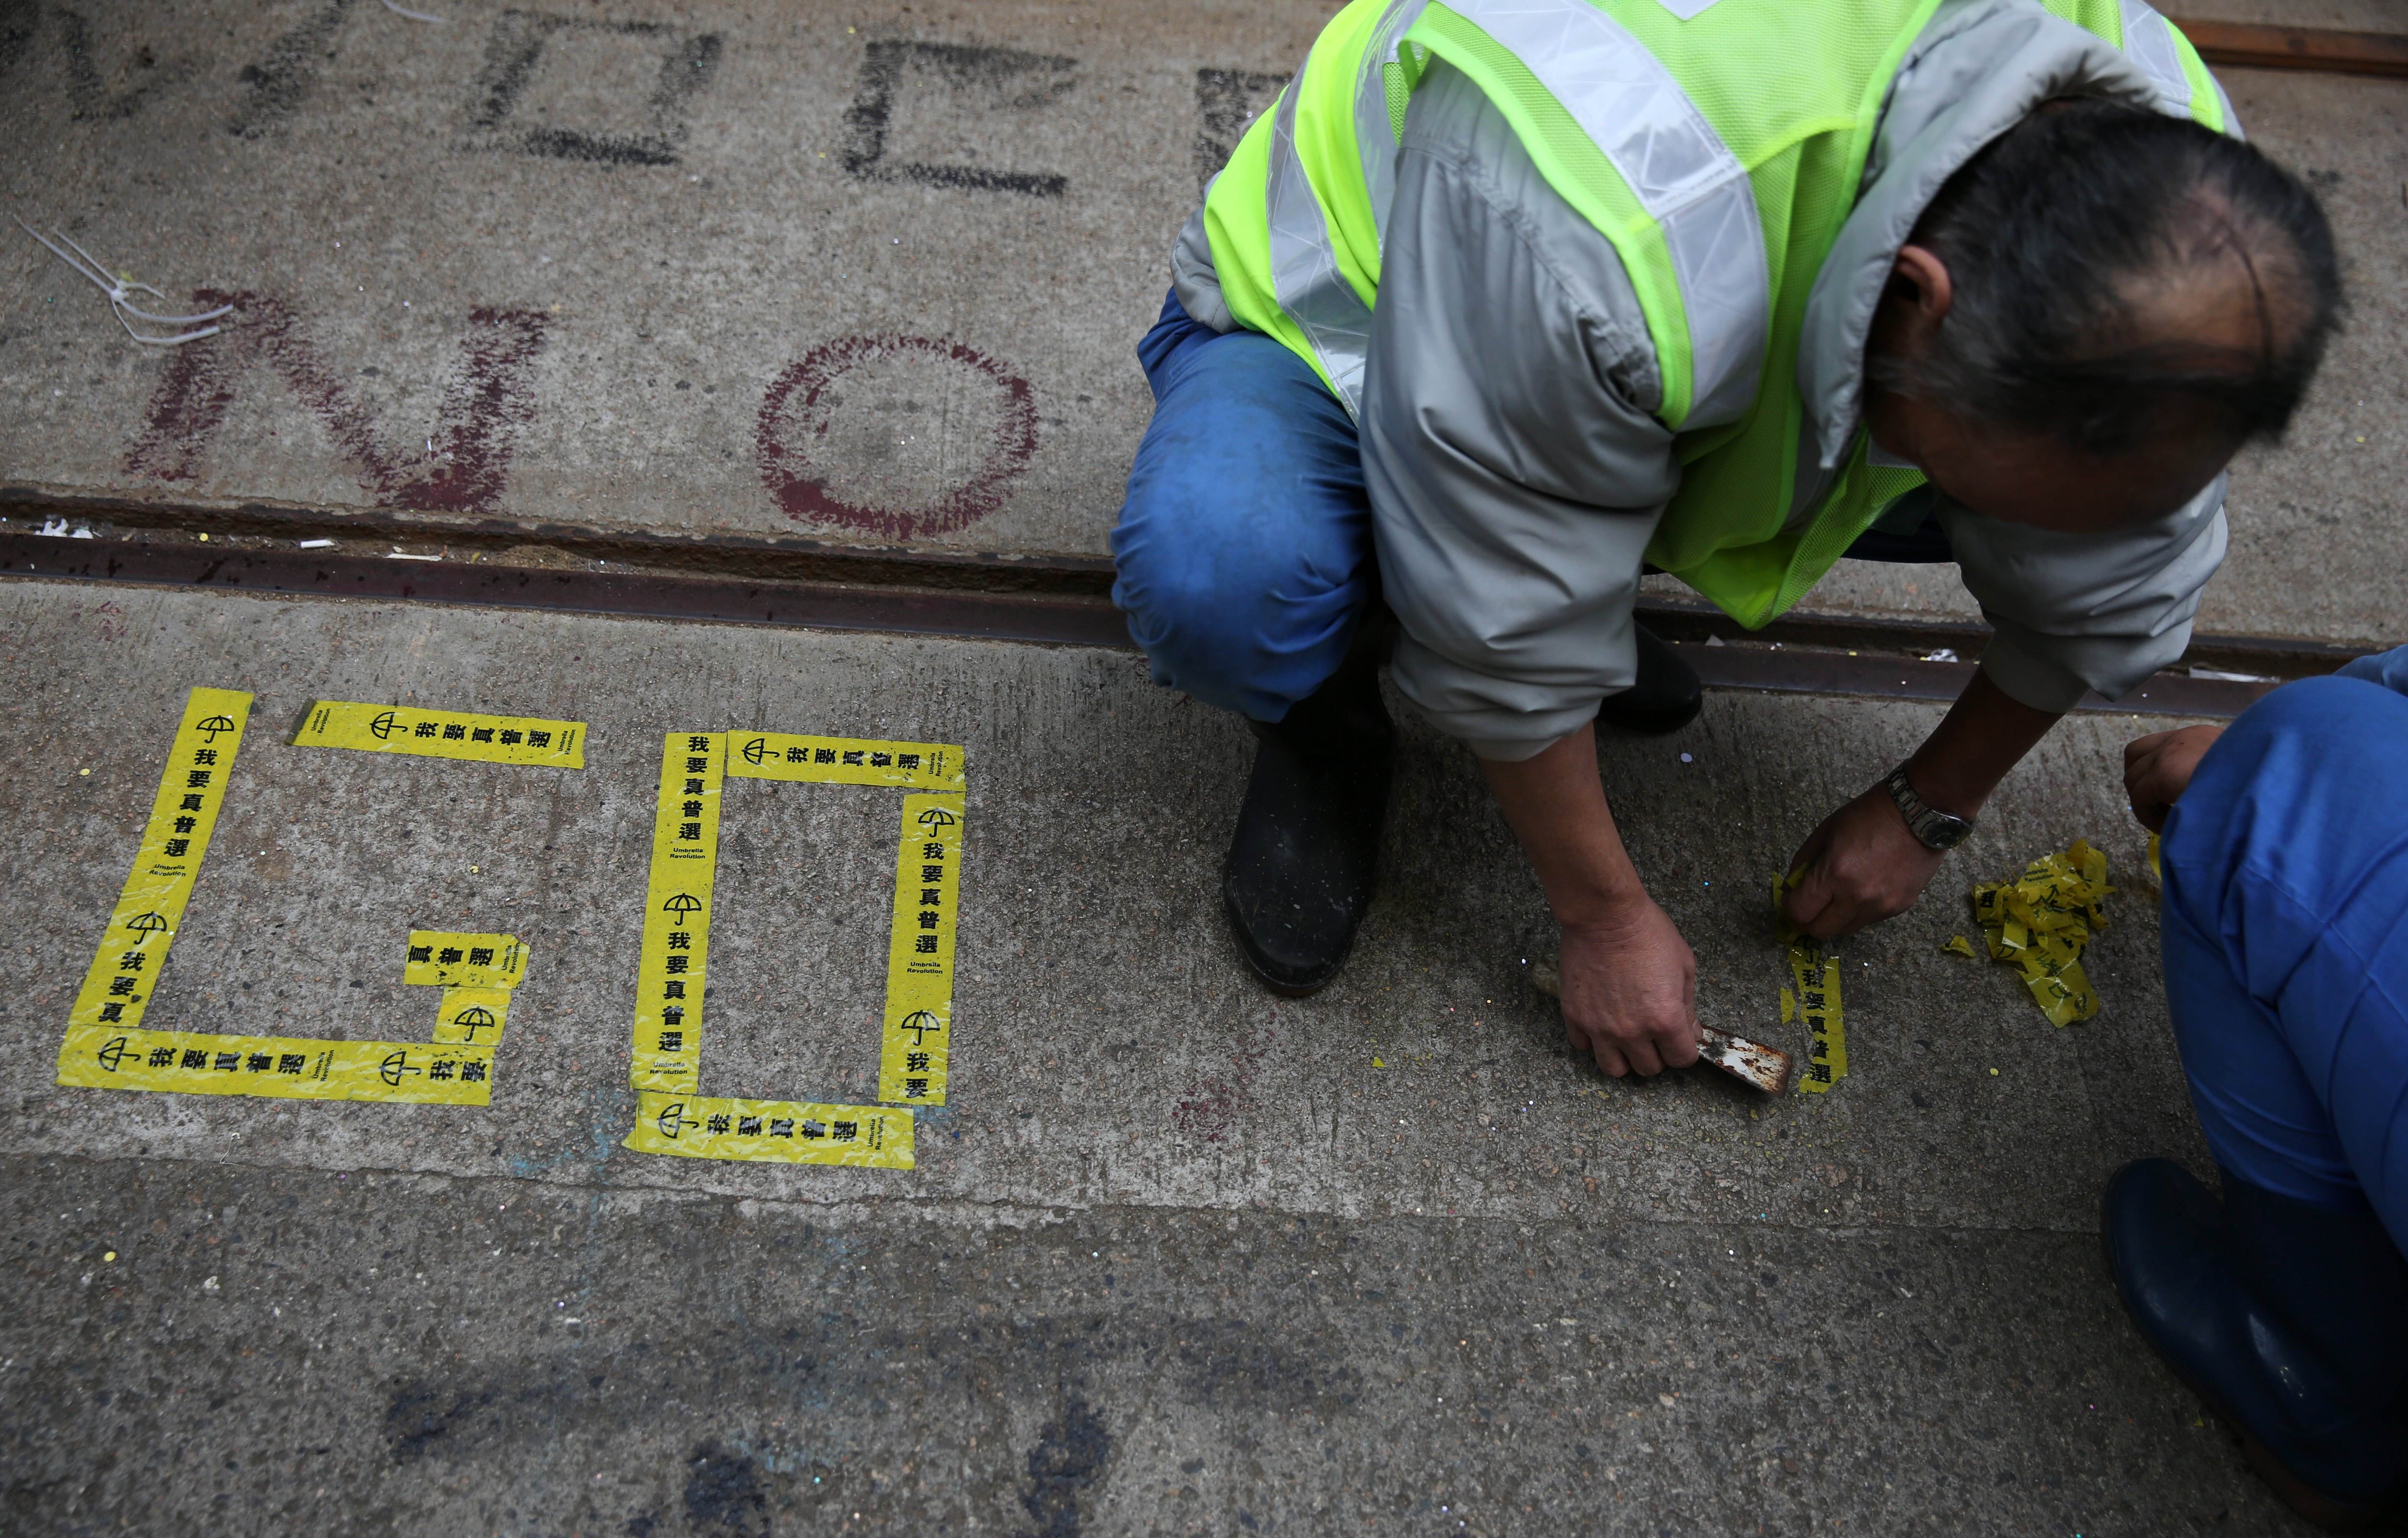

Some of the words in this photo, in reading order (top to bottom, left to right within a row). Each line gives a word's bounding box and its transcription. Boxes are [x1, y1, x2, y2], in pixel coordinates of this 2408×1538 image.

[123, 288, 1040, 539] NO
[311, 710, 323, 731] Umbrella
[317, 708, 331, 733] Revolution
[415, 722, 552, 748] 我要真普選
[558, 730, 568, 751] Umbrella
[564, 729, 576, 755] Revolution
[787, 747, 920, 770] 我要真普選
[679, 736, 709, 840] 我要真普選
[163, 749, 217, 857] 我要真普選
[916, 843, 944, 953] 我要真普選
[408, 945, 494, 966] 真普選
[502, 945, 512, 970] Umbrella
[509, 942, 520, 973] Revolution
[98, 951, 145, 1023] 我要真
[658, 932, 691, 1051] 我要真普選
[149, 1047, 306, 1075] 我要真普選
[313, 1052, 326, 1079] Umbrella
[321, 1049, 334, 1082] Revolution
[430, 1060, 487, 1082] 我要
[905, 1052, 929, 1098] 我要
[707, 1114, 857, 1142] 我要真普選
[867, 1118, 876, 1147] Umbrella
[875, 1116, 885, 1150] Revolution
